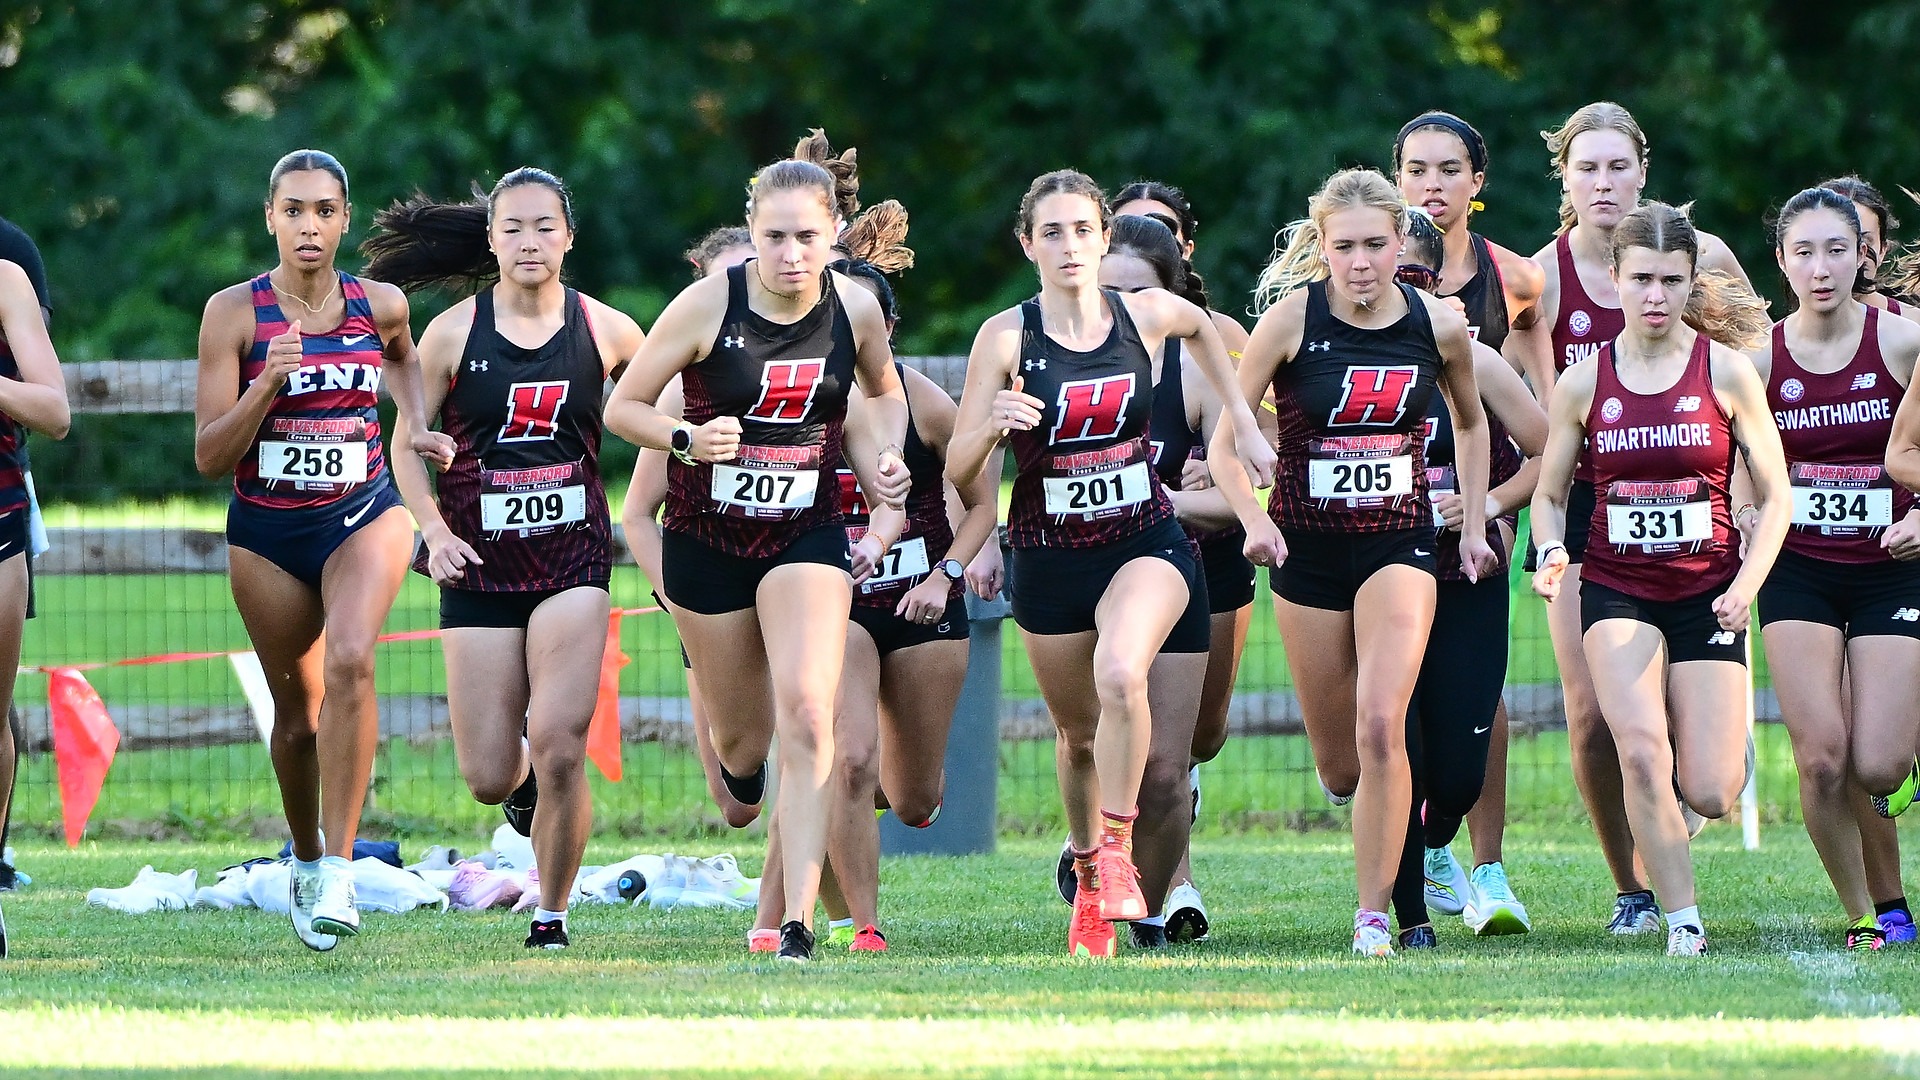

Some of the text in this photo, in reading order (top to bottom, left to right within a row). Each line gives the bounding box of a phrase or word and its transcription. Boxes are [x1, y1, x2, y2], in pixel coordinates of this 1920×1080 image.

[249, 363, 382, 396] ENN
[743, 358, 826, 423] H
[1049, 372, 1136, 446] H
[1327, 365, 1419, 427] H
[272, 419, 356, 433] HAVERFORD
[497, 380, 570, 443] H
[1775, 398, 1891, 430] SWARTHMORE
[1321, 434, 1402, 451] HAVERFORD
[1597, 423, 1711, 453] SWARTHMORE
[282, 447, 343, 476] 258
[1053, 443, 1132, 469] HAVERFORD
[492, 465, 572, 485] HAVERFORD
[1333, 464, 1392, 493] 205
[1799, 464, 1880, 480] HAVERFORD
[734, 473, 796, 503] 207
[1067, 474, 1124, 508] 201
[1617, 480, 1698, 497] HAVERFORD
[505, 493, 563, 525] 209
[1808, 493, 1868, 522] 334
[1628, 509, 1684, 539] 331
